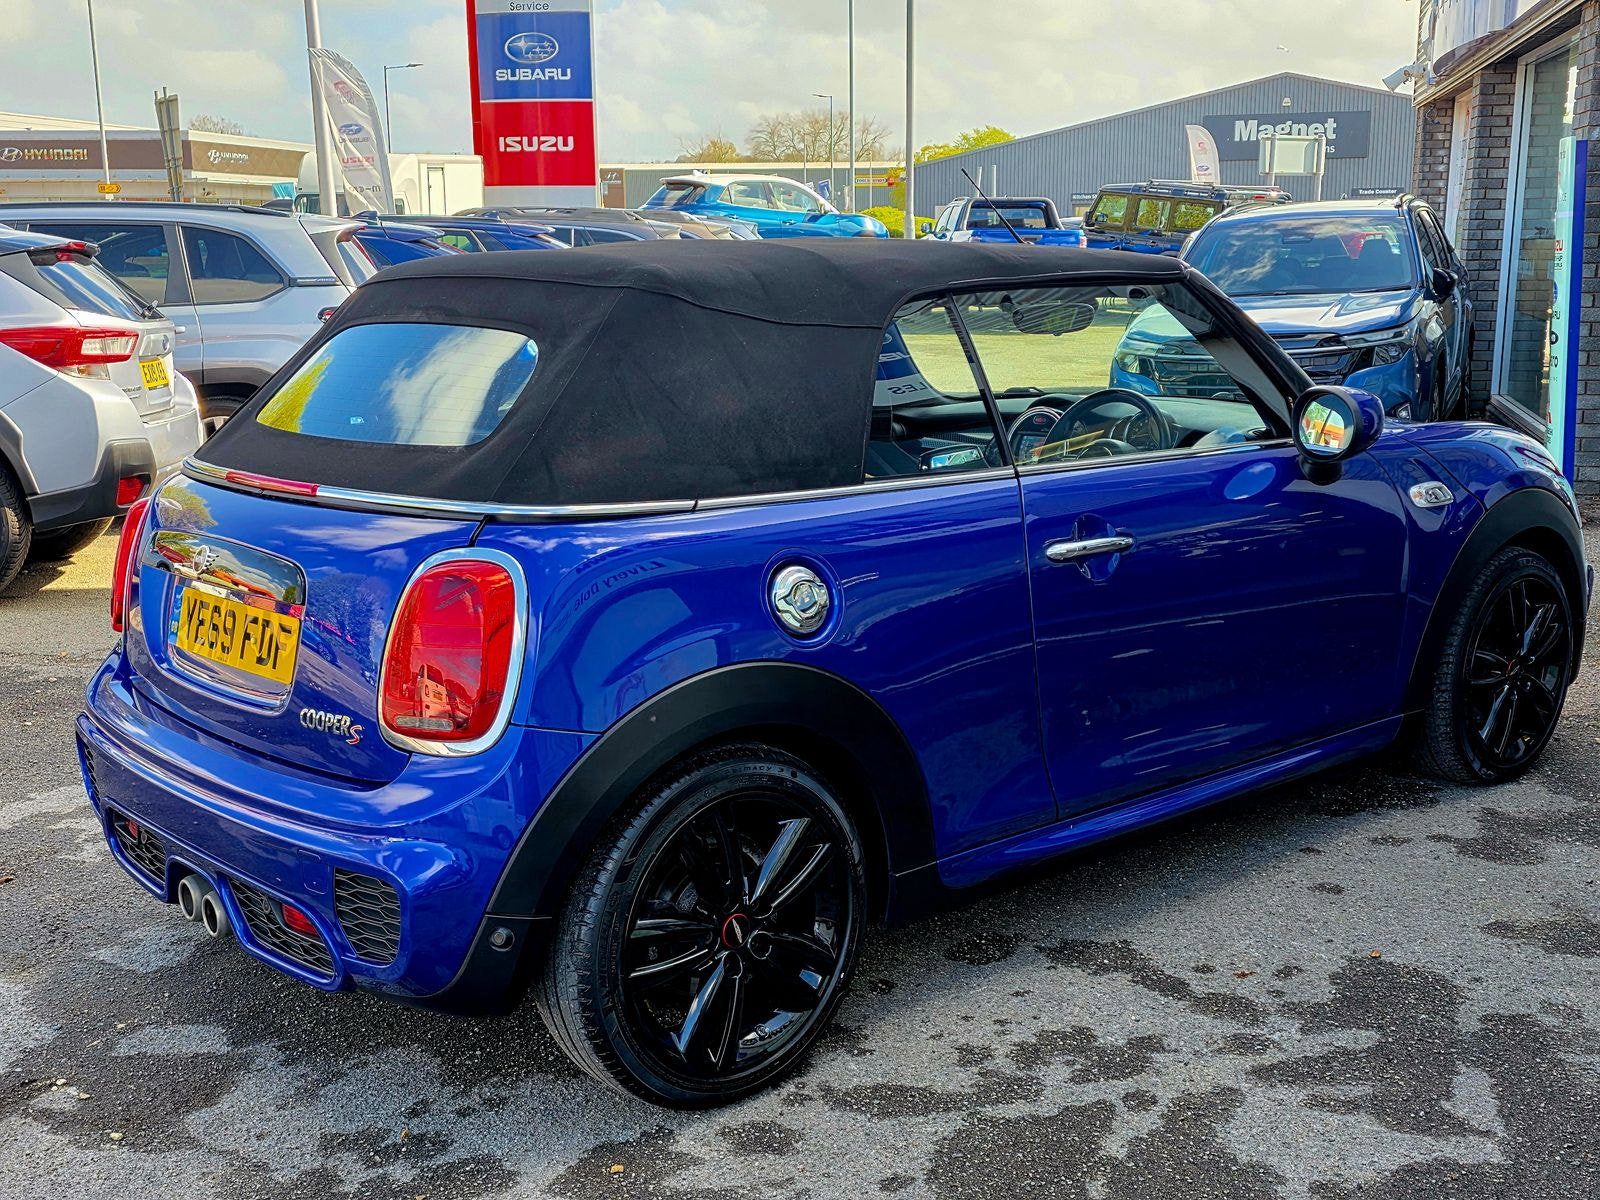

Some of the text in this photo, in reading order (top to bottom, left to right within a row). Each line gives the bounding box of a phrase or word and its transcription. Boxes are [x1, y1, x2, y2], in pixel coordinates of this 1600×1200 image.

[509, 1, 550, 11] Service
[495, 68, 571, 81] SUBARU
[1234, 117, 1337, 142] Magnet
[498, 135, 574, 152] ISUZU
[24, 148, 88, 160] HYUNDAI
[187, 596, 293, 670] YE69 FDF
[299, 708, 363, 745] COOPER S
